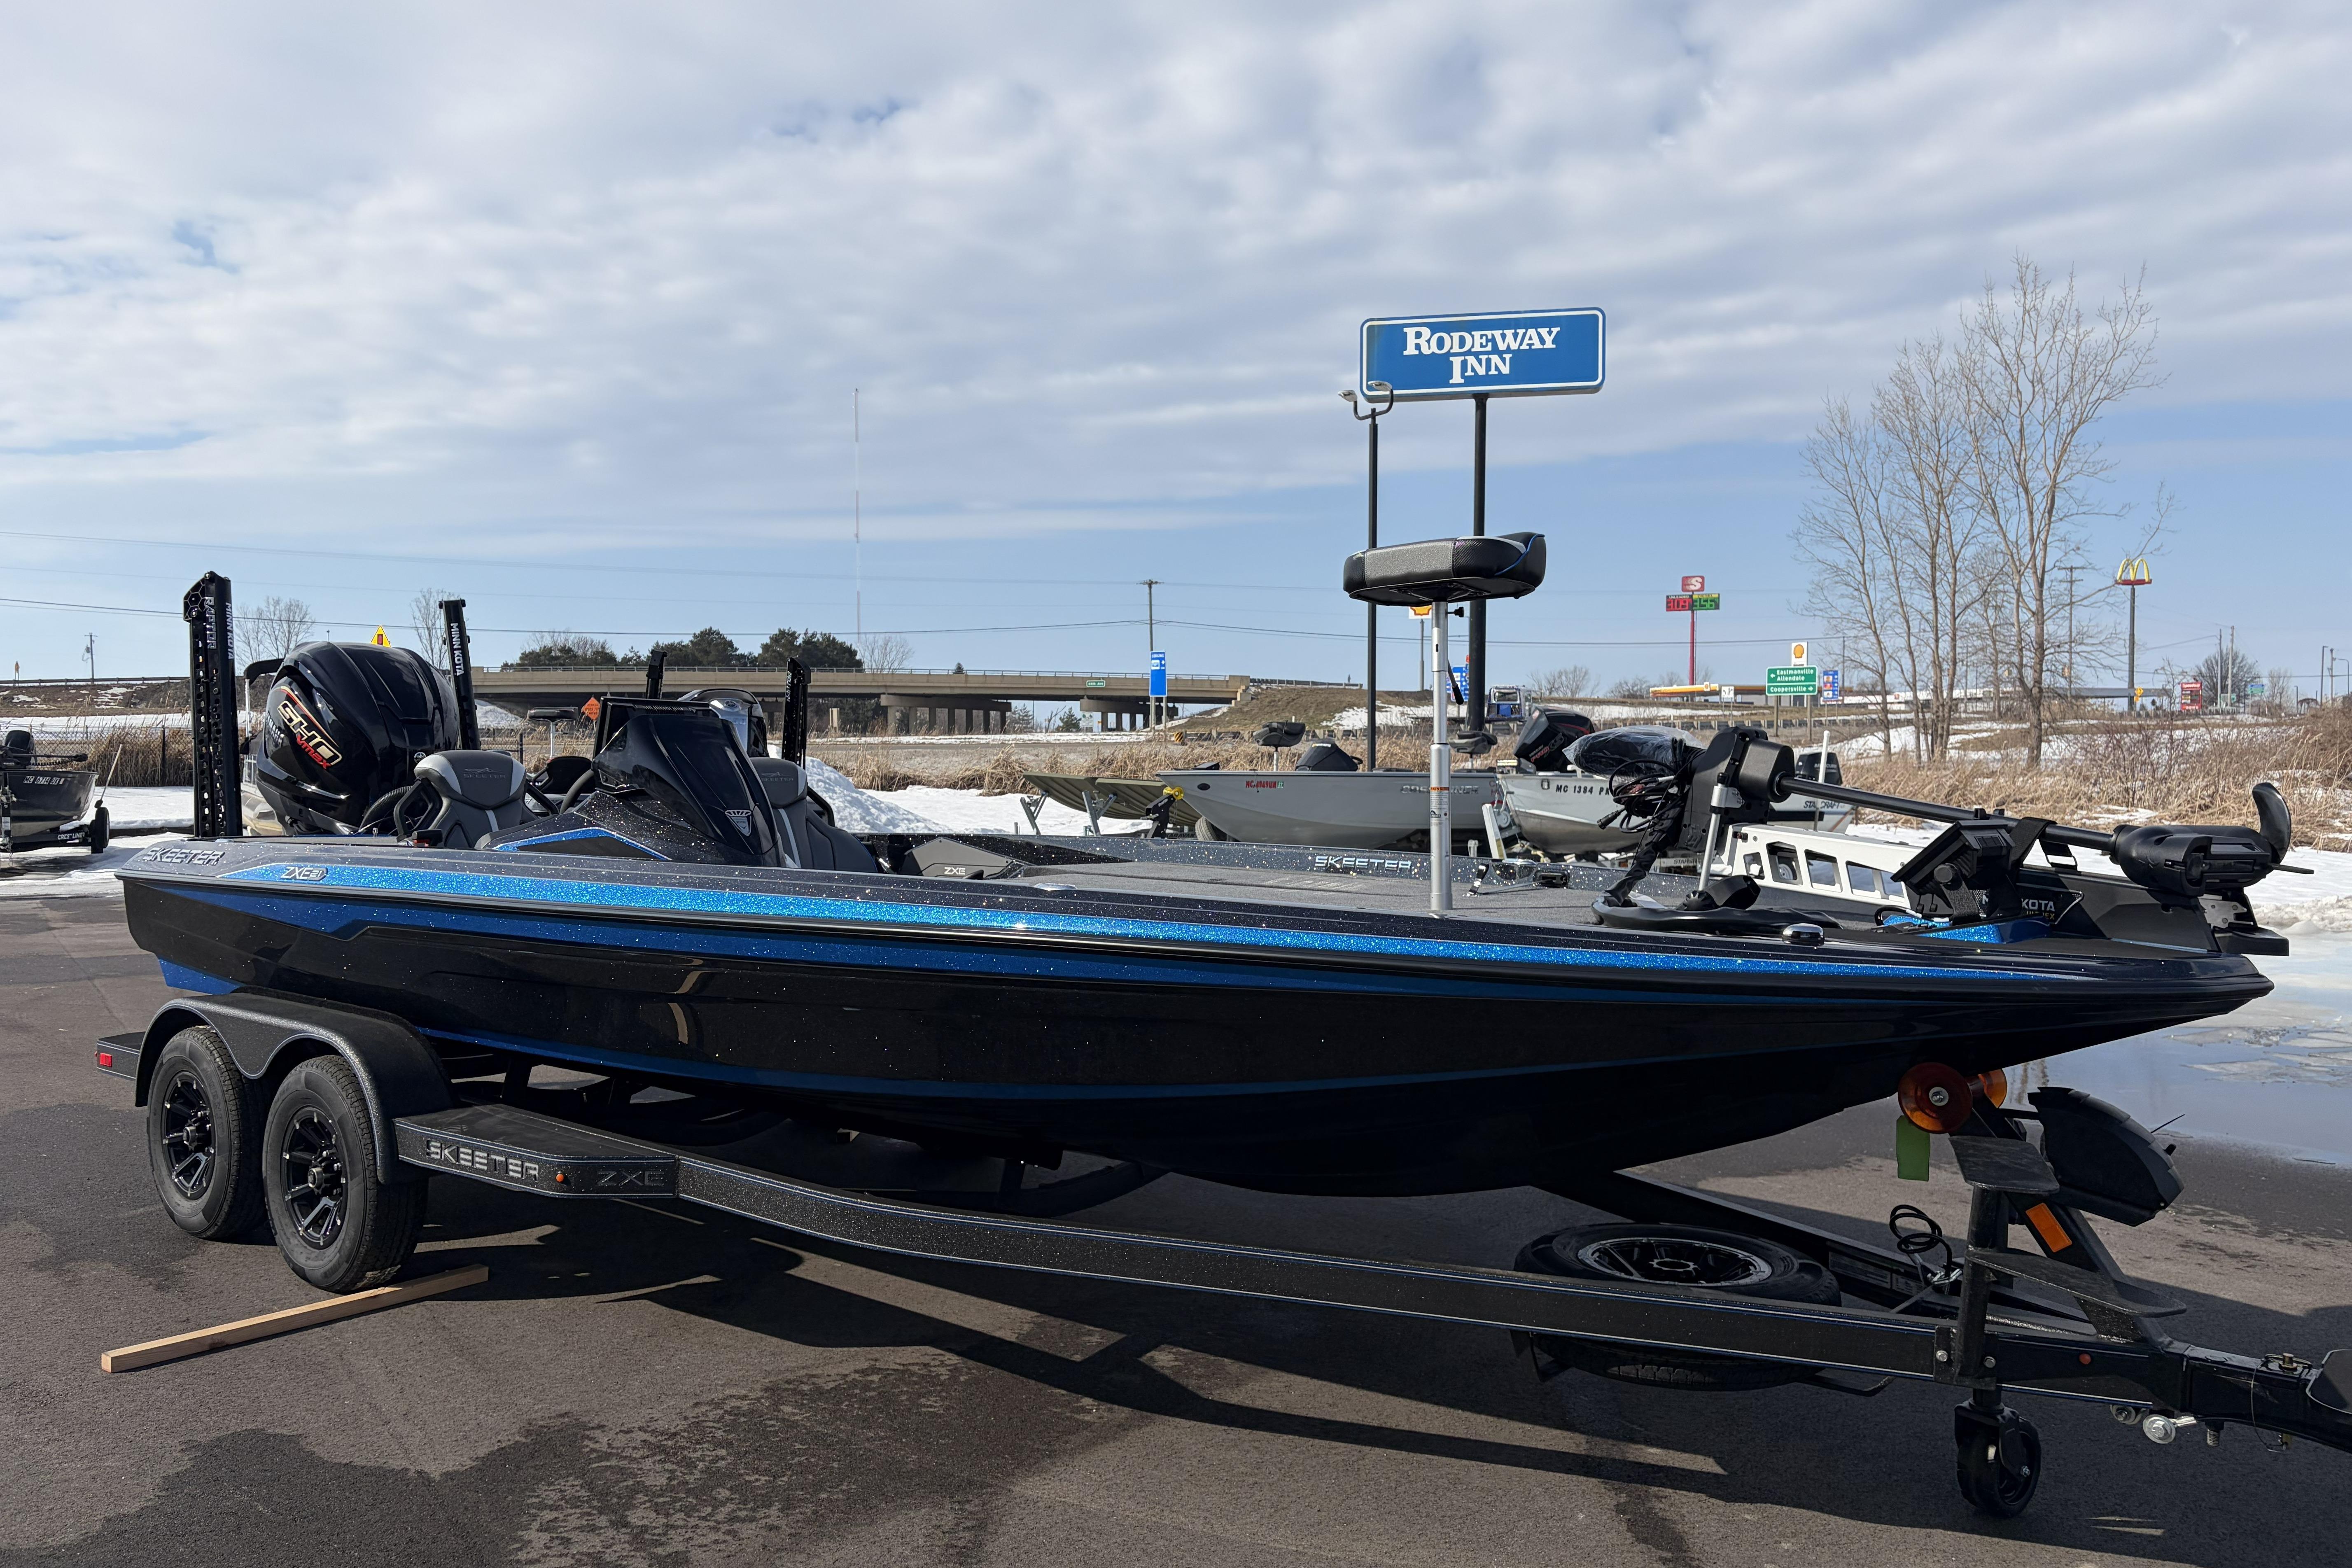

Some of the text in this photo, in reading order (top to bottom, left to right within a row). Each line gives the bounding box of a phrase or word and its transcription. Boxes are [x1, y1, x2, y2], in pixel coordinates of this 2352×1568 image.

[1403, 327, 1561, 355] RODEWAY
[1449, 354, 1512, 384] INN
[204, 597, 217, 649] RAPTOR
[225, 602, 233, 632] MINN
[450, 623, 464, 676] MINN KOTA
[1556, 784, 1568, 793] MC
[1573, 785, 1594, 794] 1384
[142, 847, 225, 865] SKEETER
[1315, 856, 1412, 873] SKEETER
[944, 867, 966, 875] ZXE
[2021, 898, 2056, 912] KOTA
[426, 1139, 539, 1181] SKEETER
[596, 1170, 665, 1186] ZXE
